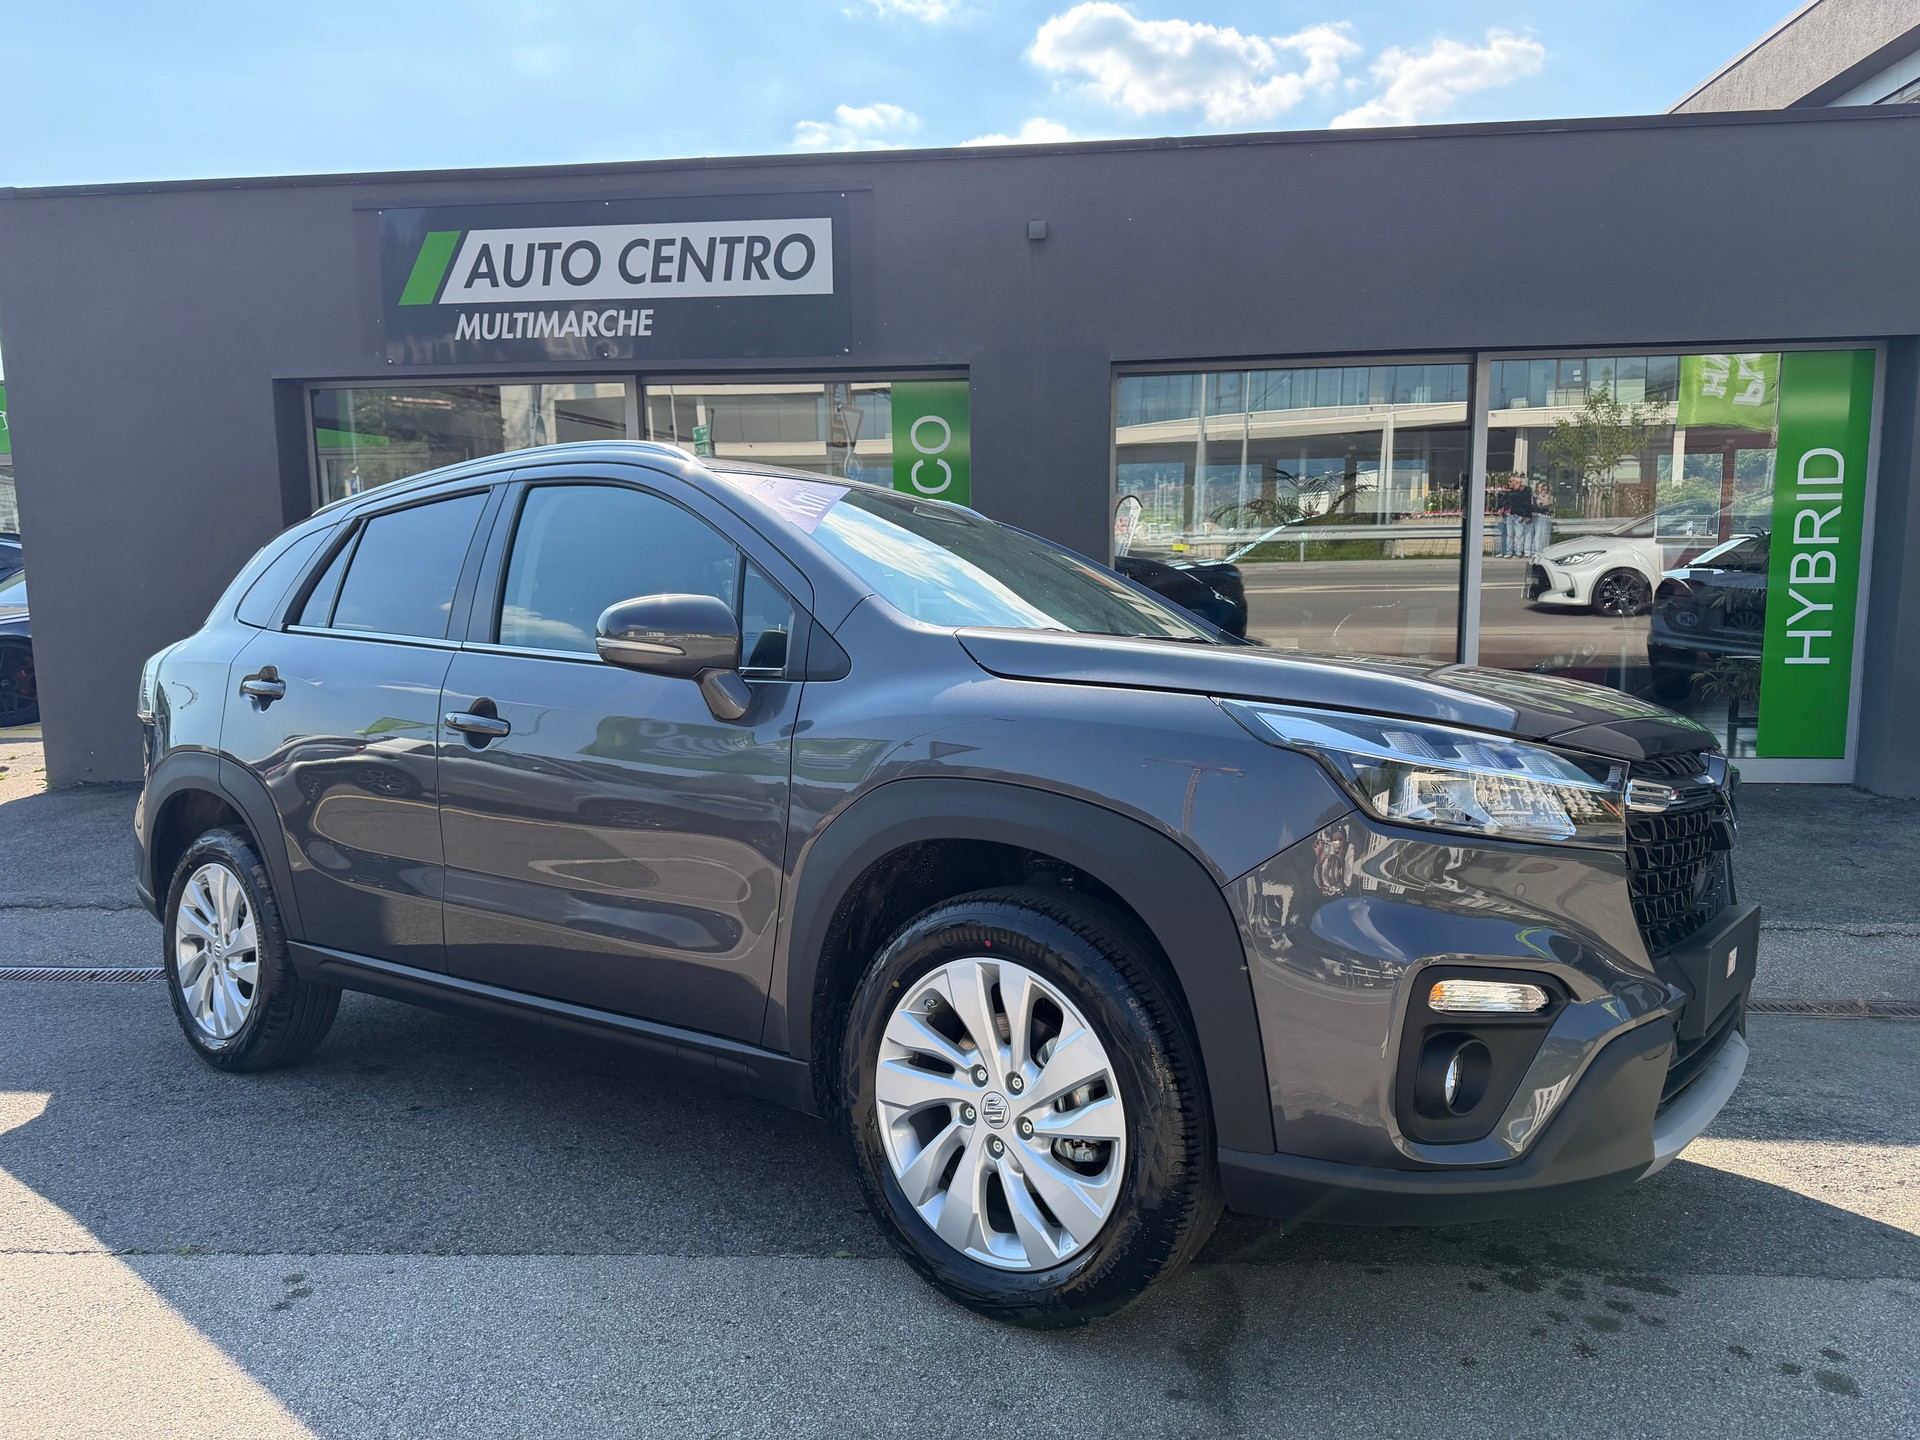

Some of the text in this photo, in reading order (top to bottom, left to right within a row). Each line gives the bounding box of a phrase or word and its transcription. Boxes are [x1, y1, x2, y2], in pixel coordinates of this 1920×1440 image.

[464, 233, 816, 289] AUTO CENTRO
[455, 309, 654, 341] MULTIMARCHE
[1784, 447, 1845, 665] HYBRID
